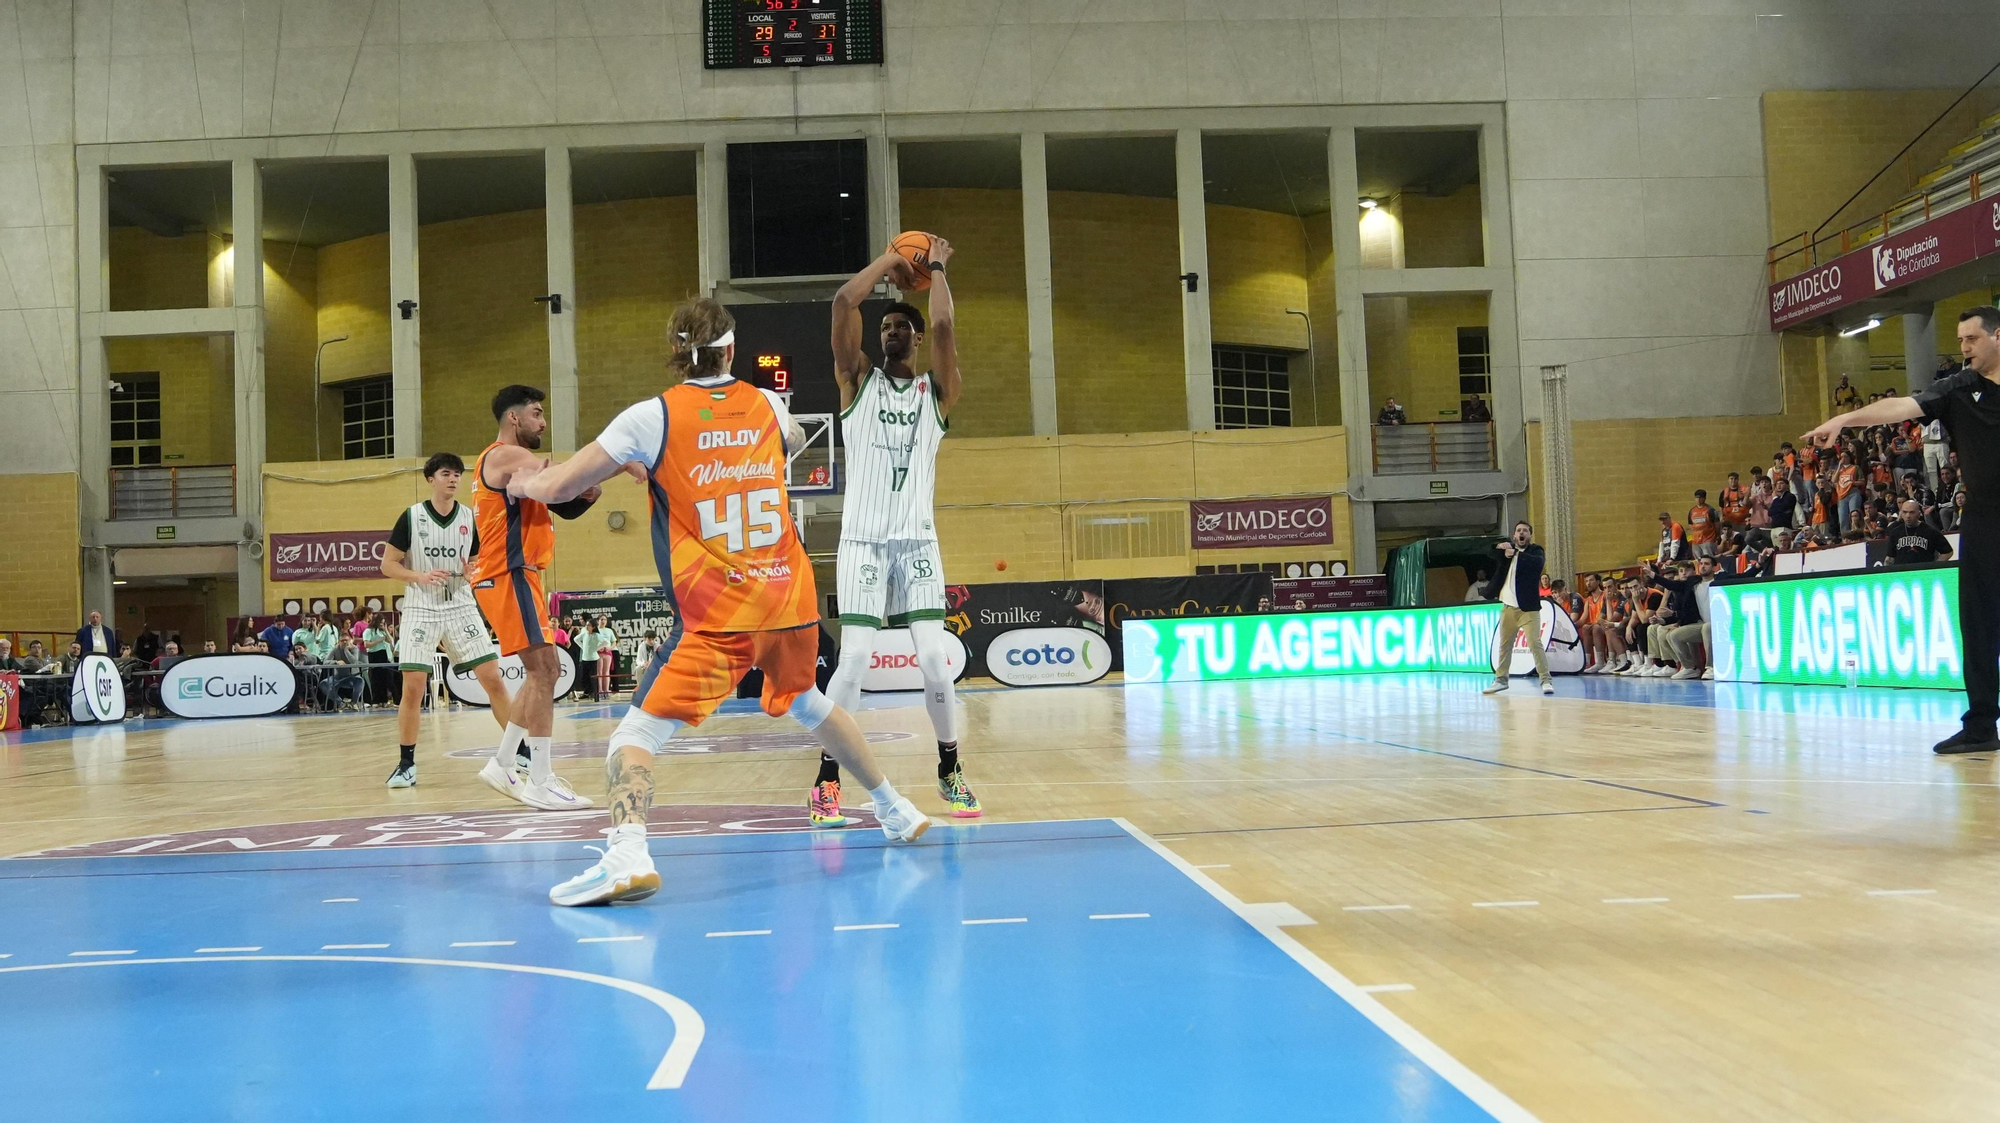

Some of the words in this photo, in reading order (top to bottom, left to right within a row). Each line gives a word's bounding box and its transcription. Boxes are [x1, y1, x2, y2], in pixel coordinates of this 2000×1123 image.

[755, 26, 773, 40] 29
[789, 20, 797, 30] 2
[819, 25, 836, 38] 37
[763, 45, 770, 56] 5
[826, 43, 833, 54] 3
[1896, 236, 1938, 261] Diputación
[1898, 264, 1908, 276] de
[1909, 252, 1940, 273] Córdoba
[1787, 266, 1841, 306] IMDECO
[775, 371, 786, 390] 9
[878, 410, 916, 426] coto
[698, 429, 760, 450] ORLOV
[689, 456, 776, 486] Wheyland
[892, 467, 910, 492] 17
[695, 488, 783, 553] 45
[1227, 508, 1326, 530] IMDECO
[306, 541, 387, 562] IMDEC
[424, 545, 456, 557] coto
[1896, 536, 1928, 550] JORDAN
[748, 563, 791, 577] MORÓN
[635, 601, 651, 612] CCB
[980, 607, 1040, 624] Smilke
[649, 617, 674, 627] ORG
[1742, 592, 1782, 671] TU
[1792, 585, 1960, 677] AGENCIA
[1176, 622, 1234, 673] TU
[1249, 614, 1436, 671] AGENCIA
[1006, 643, 1076, 666] coto
[1007, 672, 1039, 680] Contigo,
[99, 679, 112, 697] CSIF
[205, 675, 277, 697] Cualix
